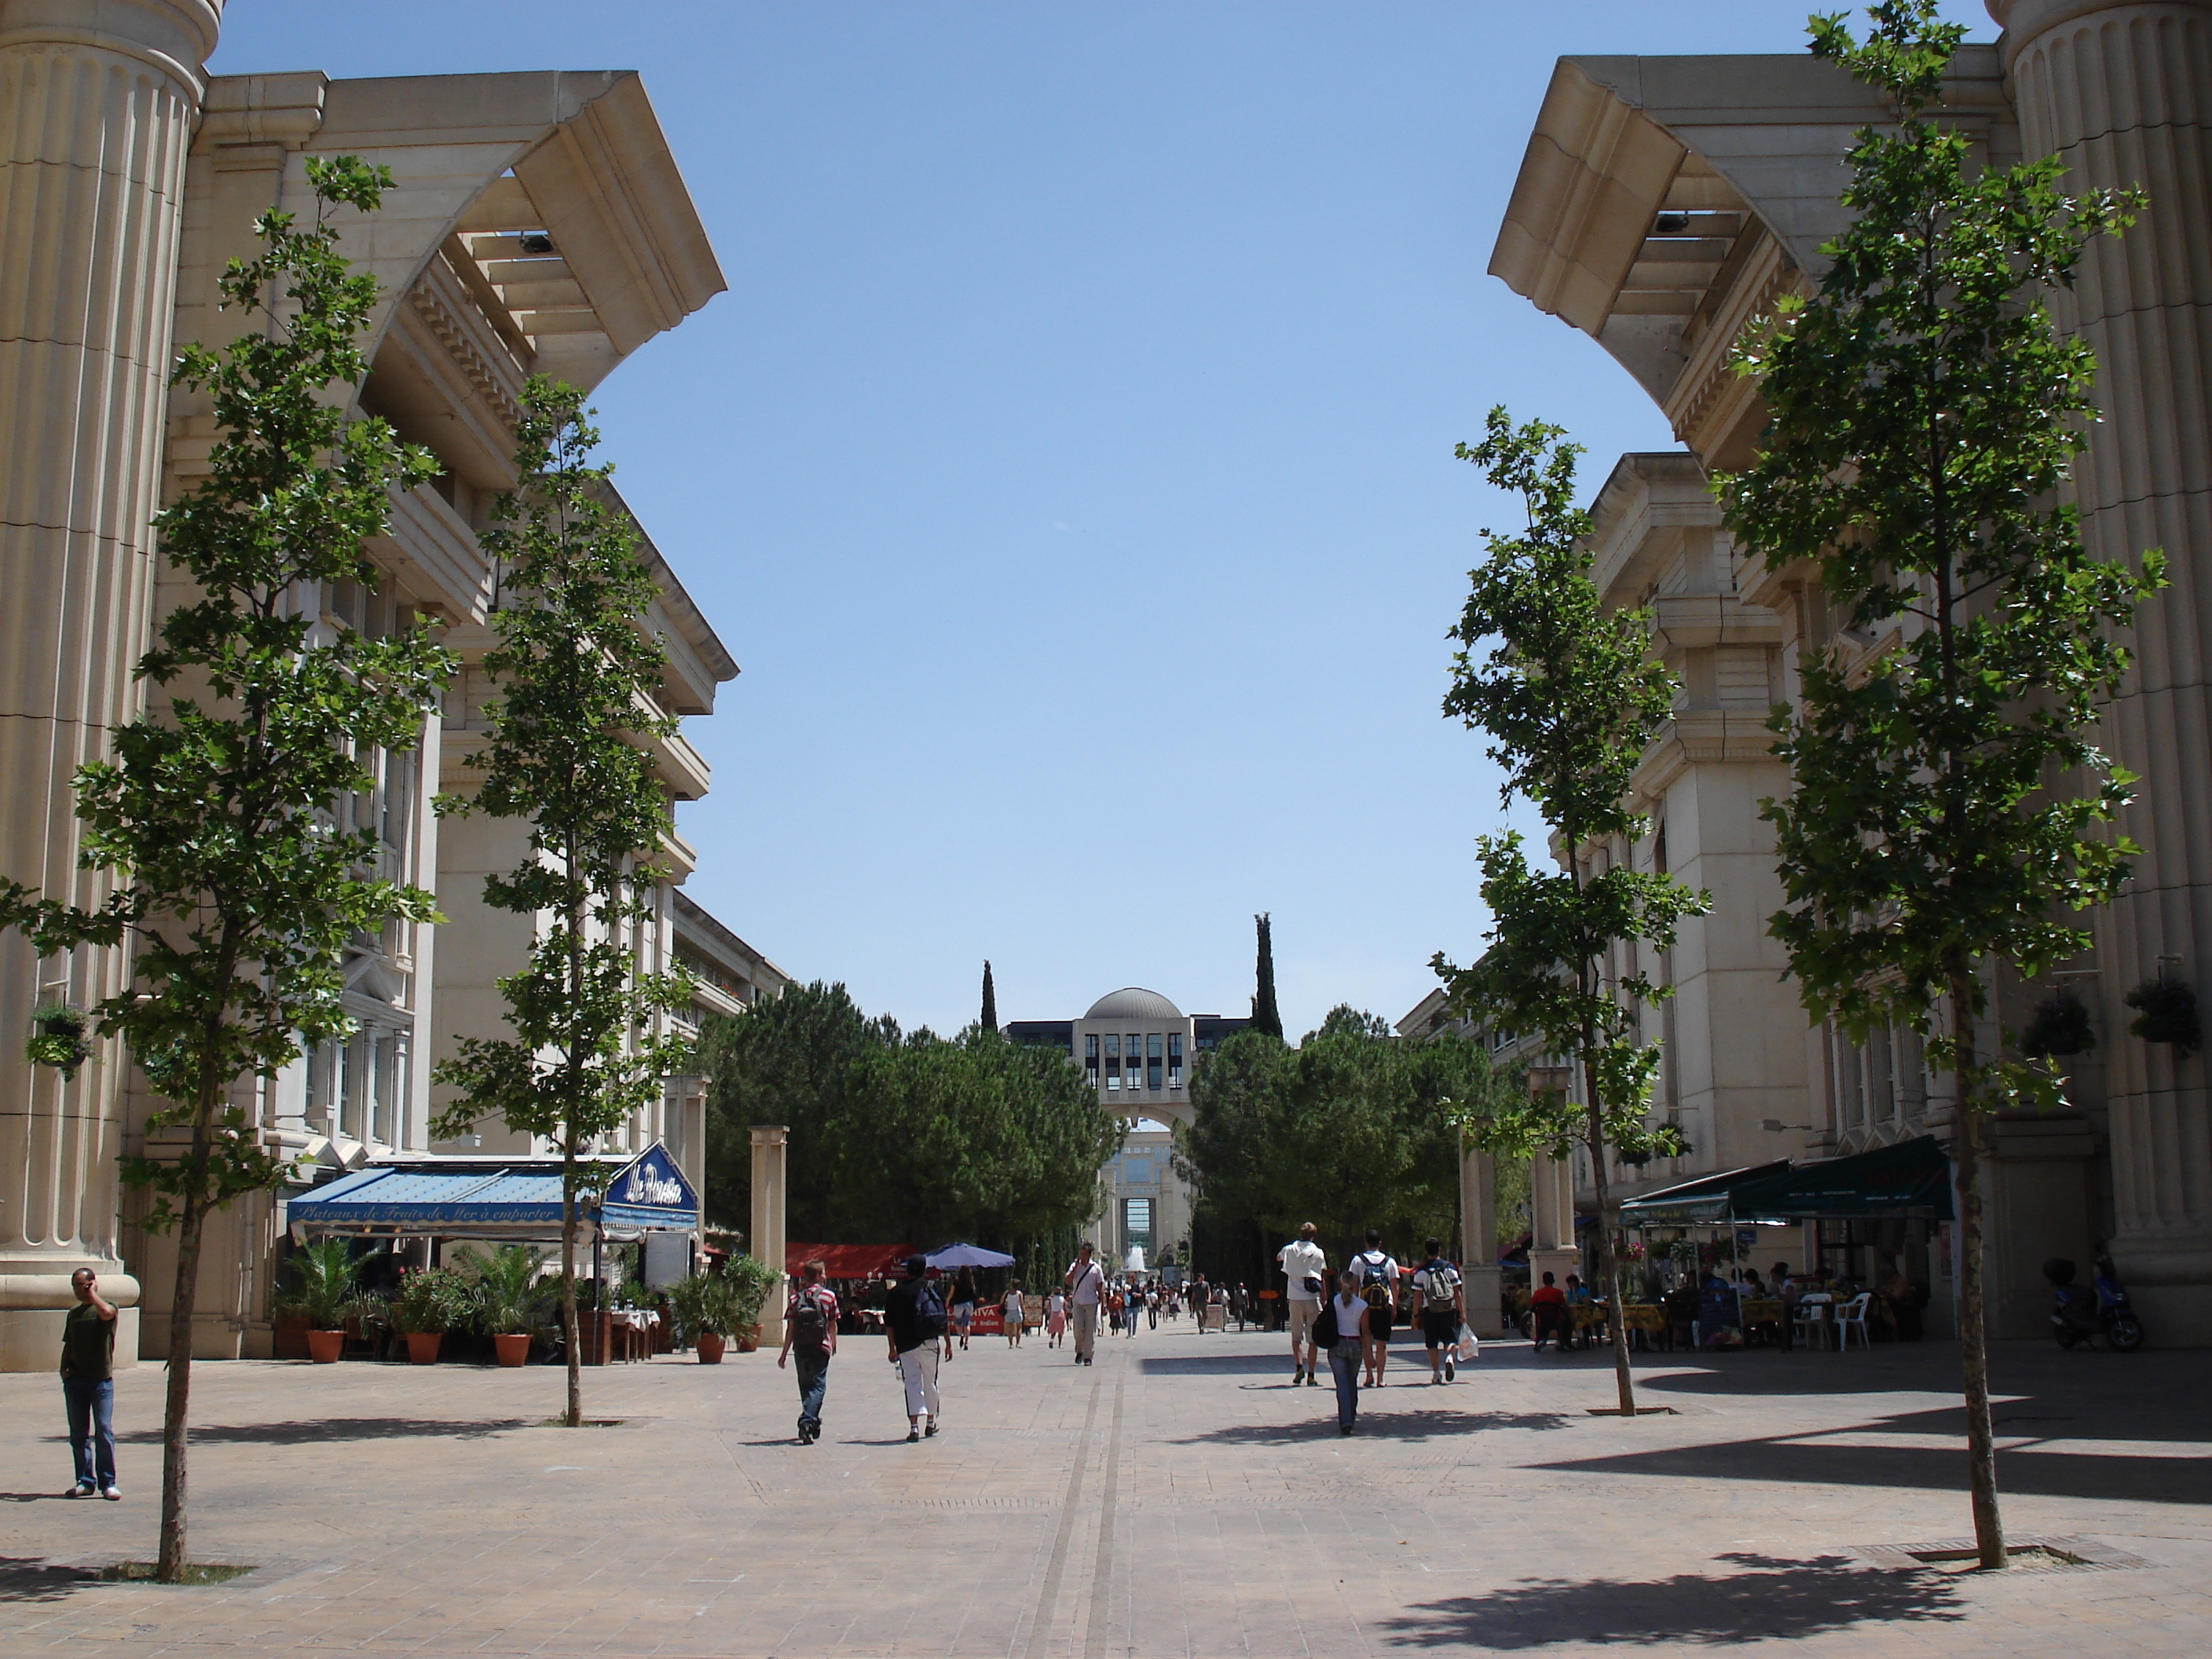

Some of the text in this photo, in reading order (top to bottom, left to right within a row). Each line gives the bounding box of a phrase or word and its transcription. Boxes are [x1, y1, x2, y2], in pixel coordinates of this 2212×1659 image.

[296, 1206, 361, 1218] Plateaux
[364, 1206, 379, 1218] de
[382, 1206, 423, 1218] Fruits
[427, 1207, 443, 1218] de
[493, 1207, 555, 1221] emporter
